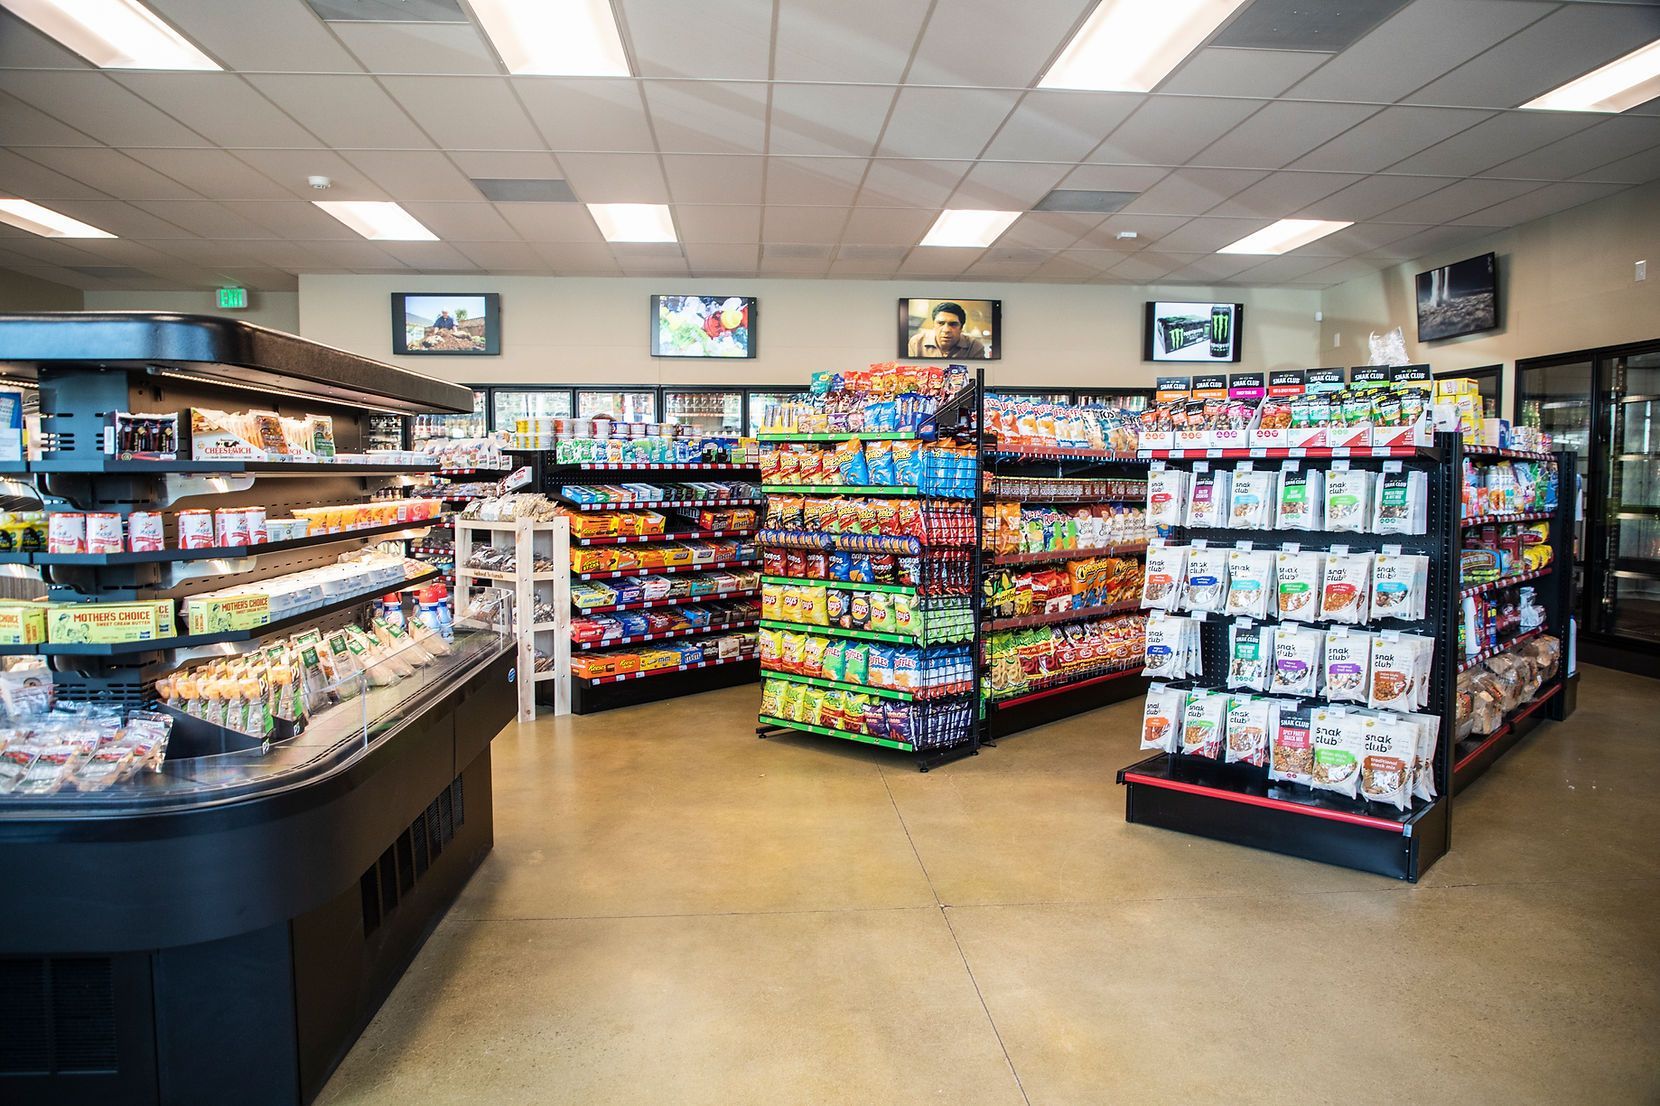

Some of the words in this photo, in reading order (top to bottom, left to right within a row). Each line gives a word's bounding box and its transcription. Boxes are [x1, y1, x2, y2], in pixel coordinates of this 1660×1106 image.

[220, 288, 243, 308] EXIT
[221, 600, 248, 612] MOTHER'S
[249, 597, 268, 608] CHOICE
[73, 611, 117, 623] MOTHER'S
[118, 610, 151, 621] CHOICE
[1375, 653, 1394, 661] snak
[1295, 720, 1310, 728] CLUB
[1316, 727, 1342, 736] snak
[1316, 736, 1338, 745] club
[1365, 734, 1392, 744] snak
[1365, 743, 1388, 753] club
